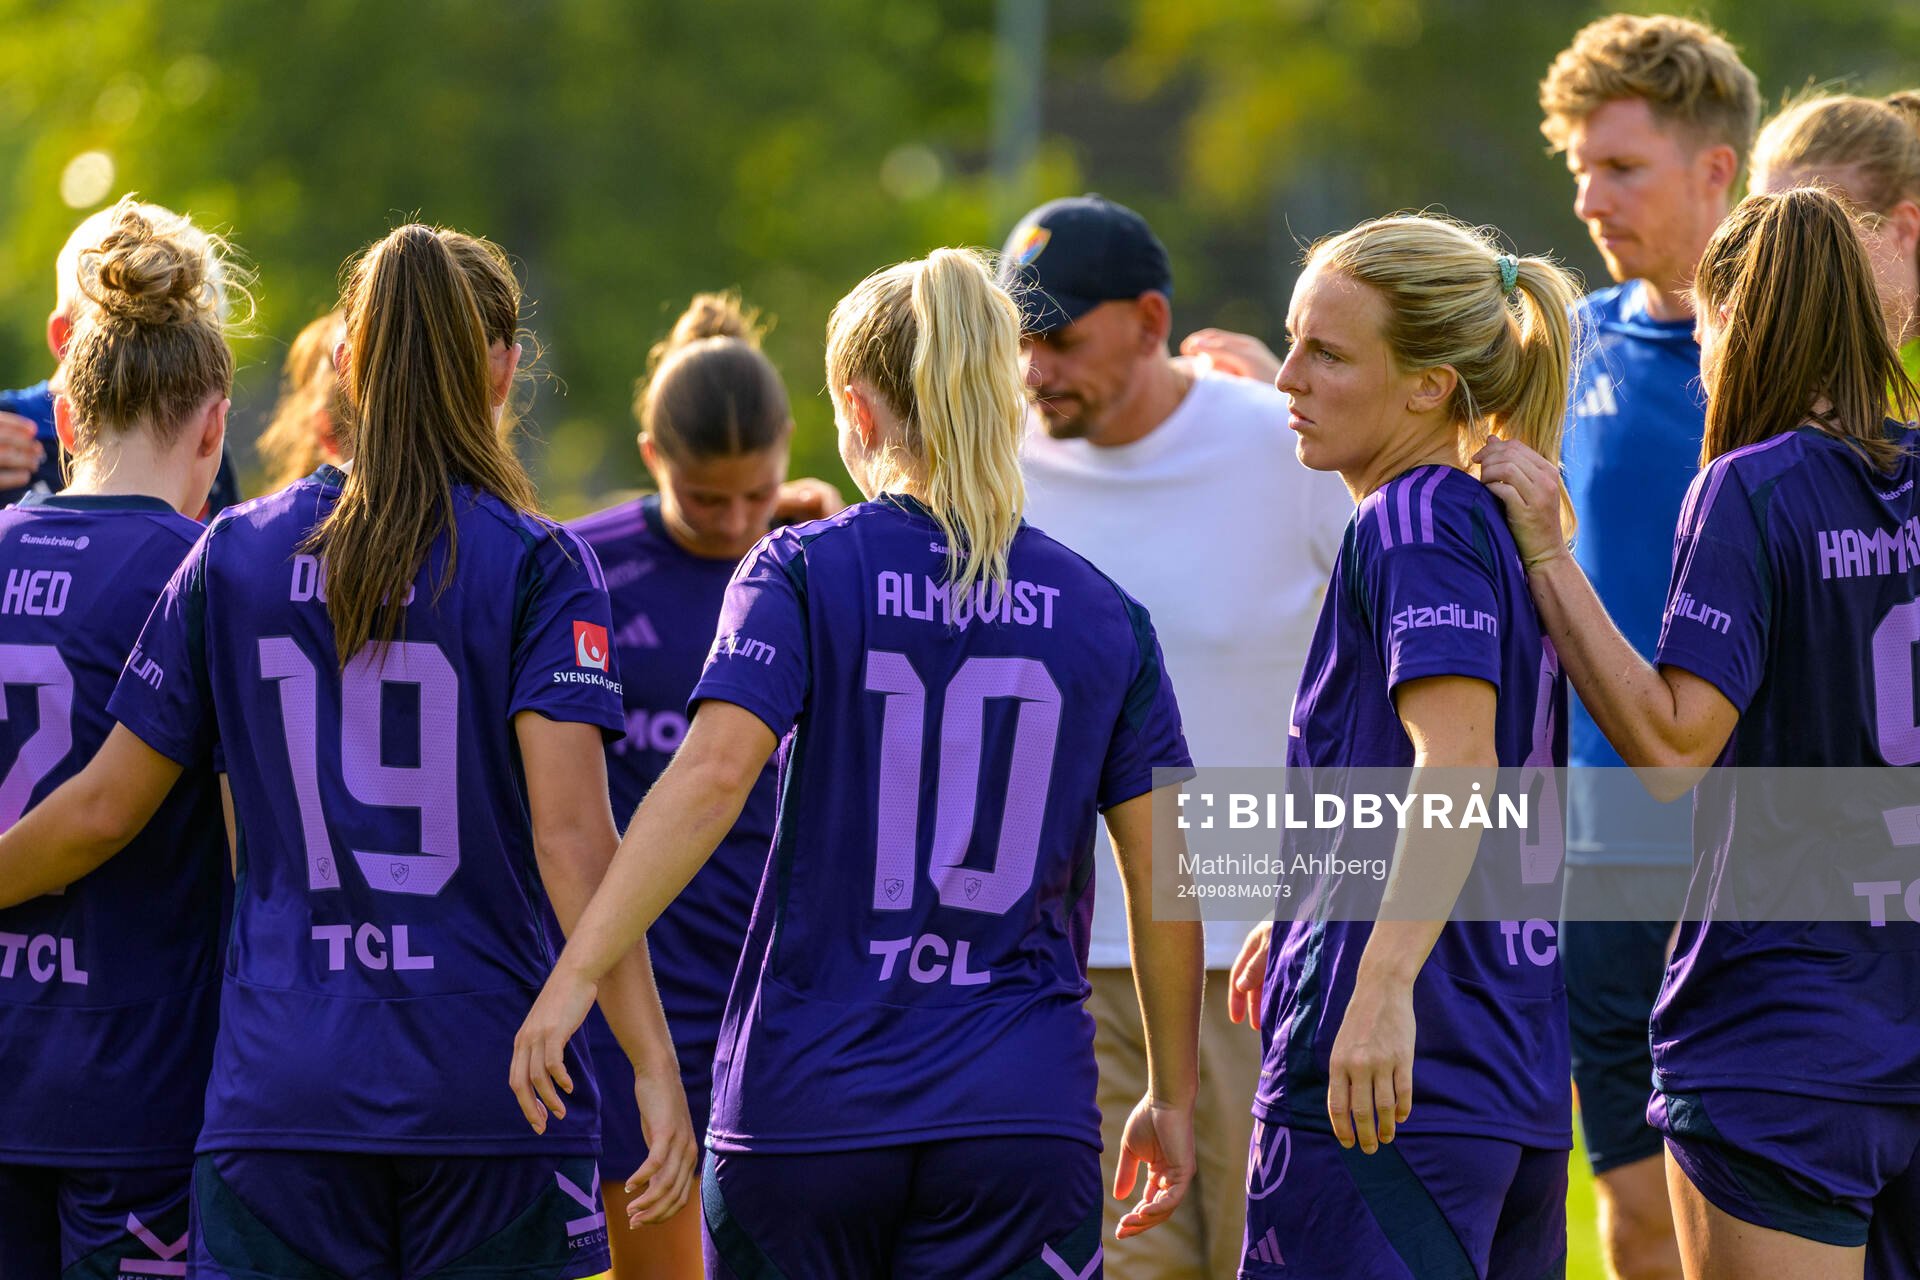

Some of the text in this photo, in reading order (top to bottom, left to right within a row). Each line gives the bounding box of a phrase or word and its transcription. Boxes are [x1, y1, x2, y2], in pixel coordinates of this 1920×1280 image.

[20, 533, 75, 548] Sundström
[1, 568, 73, 617] HED
[877, 570, 1061, 633] ALMQVIST
[1392, 603, 1497, 638] stadium
[553, 671, 624, 696] SVENSKA SPEL
[257, 637, 461, 897] 19
[865, 649, 1063, 916] 10
[0, 931, 89, 986] TCL
[311, 921, 435, 972] TCL
[869, 933, 992, 986] TCL
[1500, 918, 1558, 967] TC
